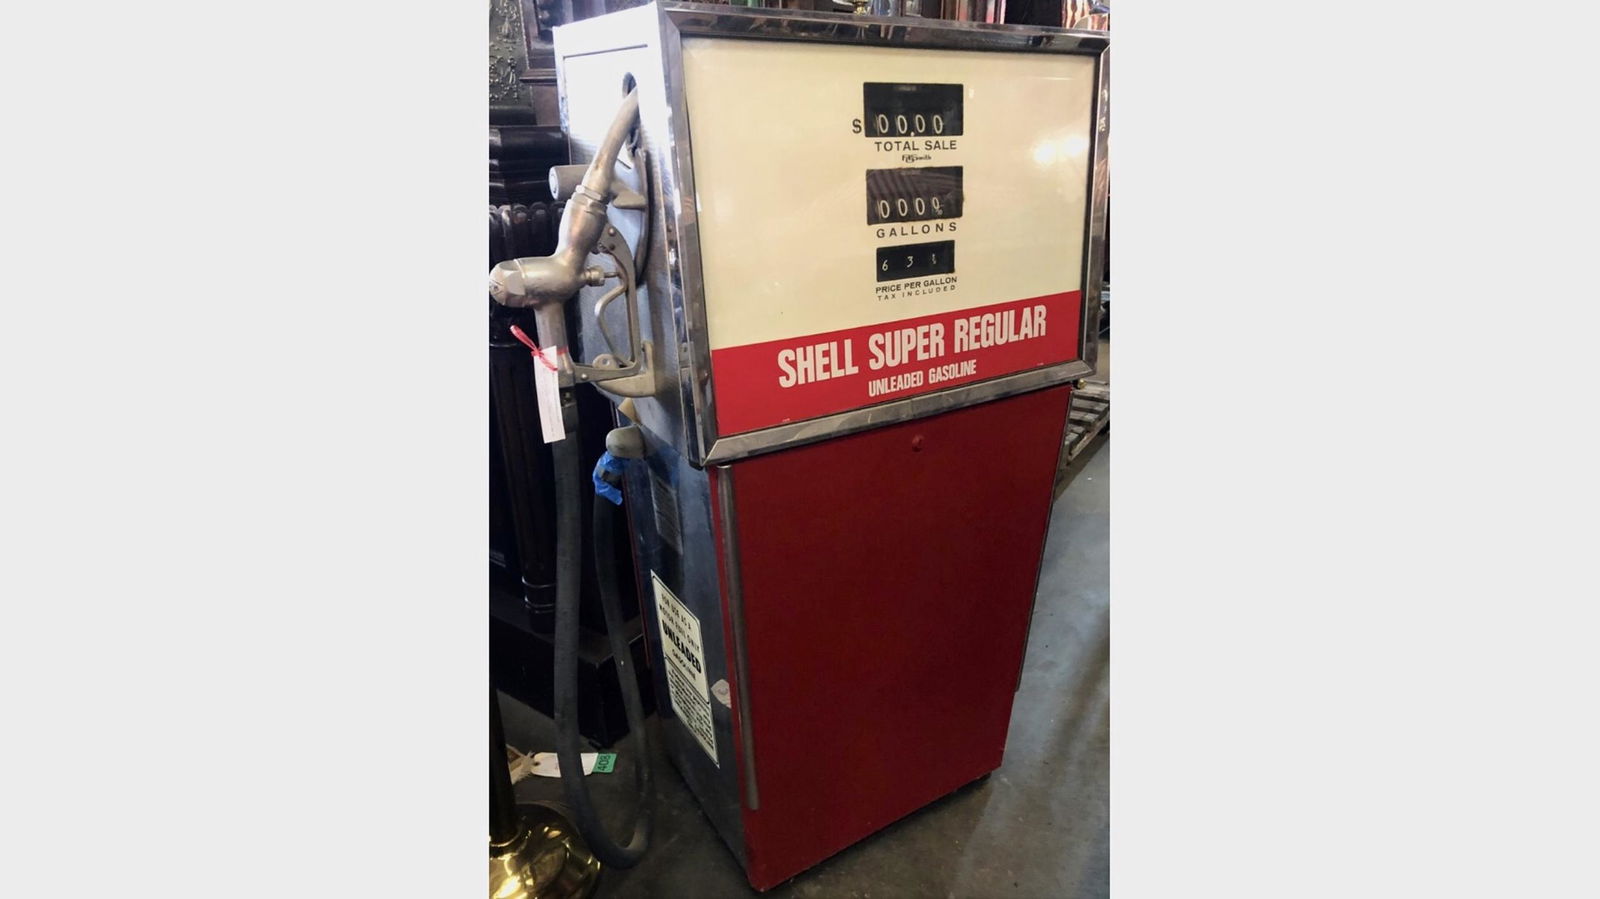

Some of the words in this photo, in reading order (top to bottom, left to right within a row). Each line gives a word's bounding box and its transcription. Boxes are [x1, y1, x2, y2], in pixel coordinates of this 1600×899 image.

[874, 140, 920, 152] TOTAL
[924, 140, 958, 151] SALE
[876, 221, 958, 239] GALLONS
[875, 283, 902, 294] PRICE
[904, 281, 922, 290] PER
[923, 276, 958, 287] GALLON
[877, 293, 896, 302] TAX
[902, 284, 956, 298] INCLUDED
[777, 338, 859, 388] SHELL
[868, 322, 945, 370] SUPER
[954, 304, 1047, 354] REGULAR
[868, 370, 924, 398] UNLEADED
[928, 359, 977, 384] GASOLINE
[661, 619, 702, 674] UNLEADED
